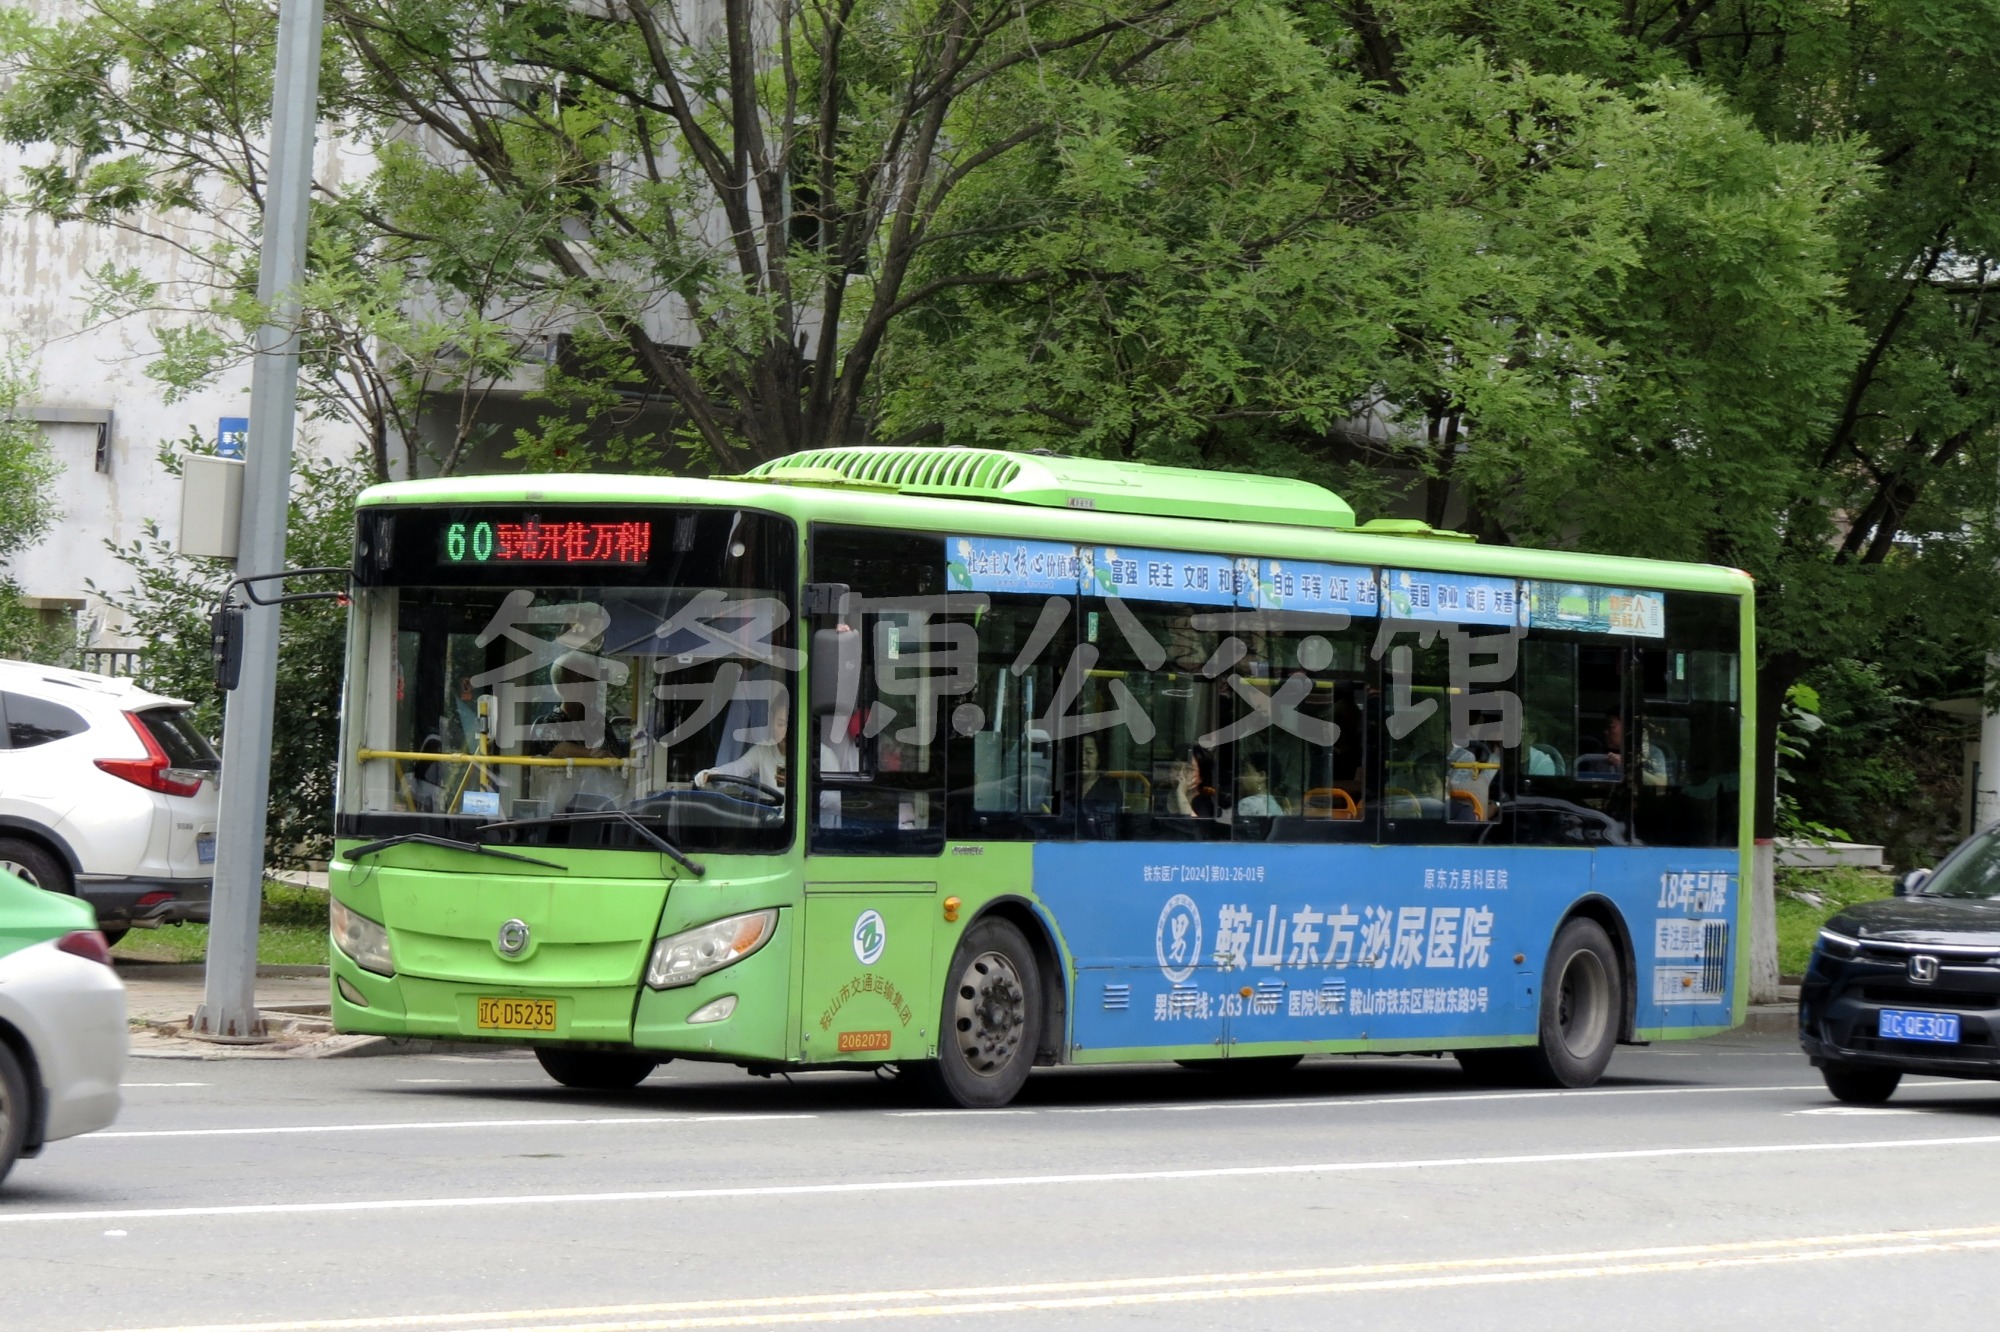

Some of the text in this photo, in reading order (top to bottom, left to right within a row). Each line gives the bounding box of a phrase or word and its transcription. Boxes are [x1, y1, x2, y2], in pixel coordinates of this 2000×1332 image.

[448, 522, 492, 561] 60
[967, 547, 1080, 578] 社会主义核心价值观
[1111, 559, 1243, 593] 富强 民主 文明 和谐
[1273, 573, 1377, 604] 自由 平等 公正 法治
[1409, 584, 1513, 614] 爱国 敬业 诚信 友善
[1424, 868, 1508, 890] 原东方男科医院
[1657, 870, 1728, 913] 18年品牌
[1213, 904, 1494, 972] 鞍山东方泌尿医院
[480, 1002, 554, 1026] 辽C·D5235
[820, 973, 912, 1032] 鞍山市交通运输集团
[841, 1033, 889, 1048] 2062073
